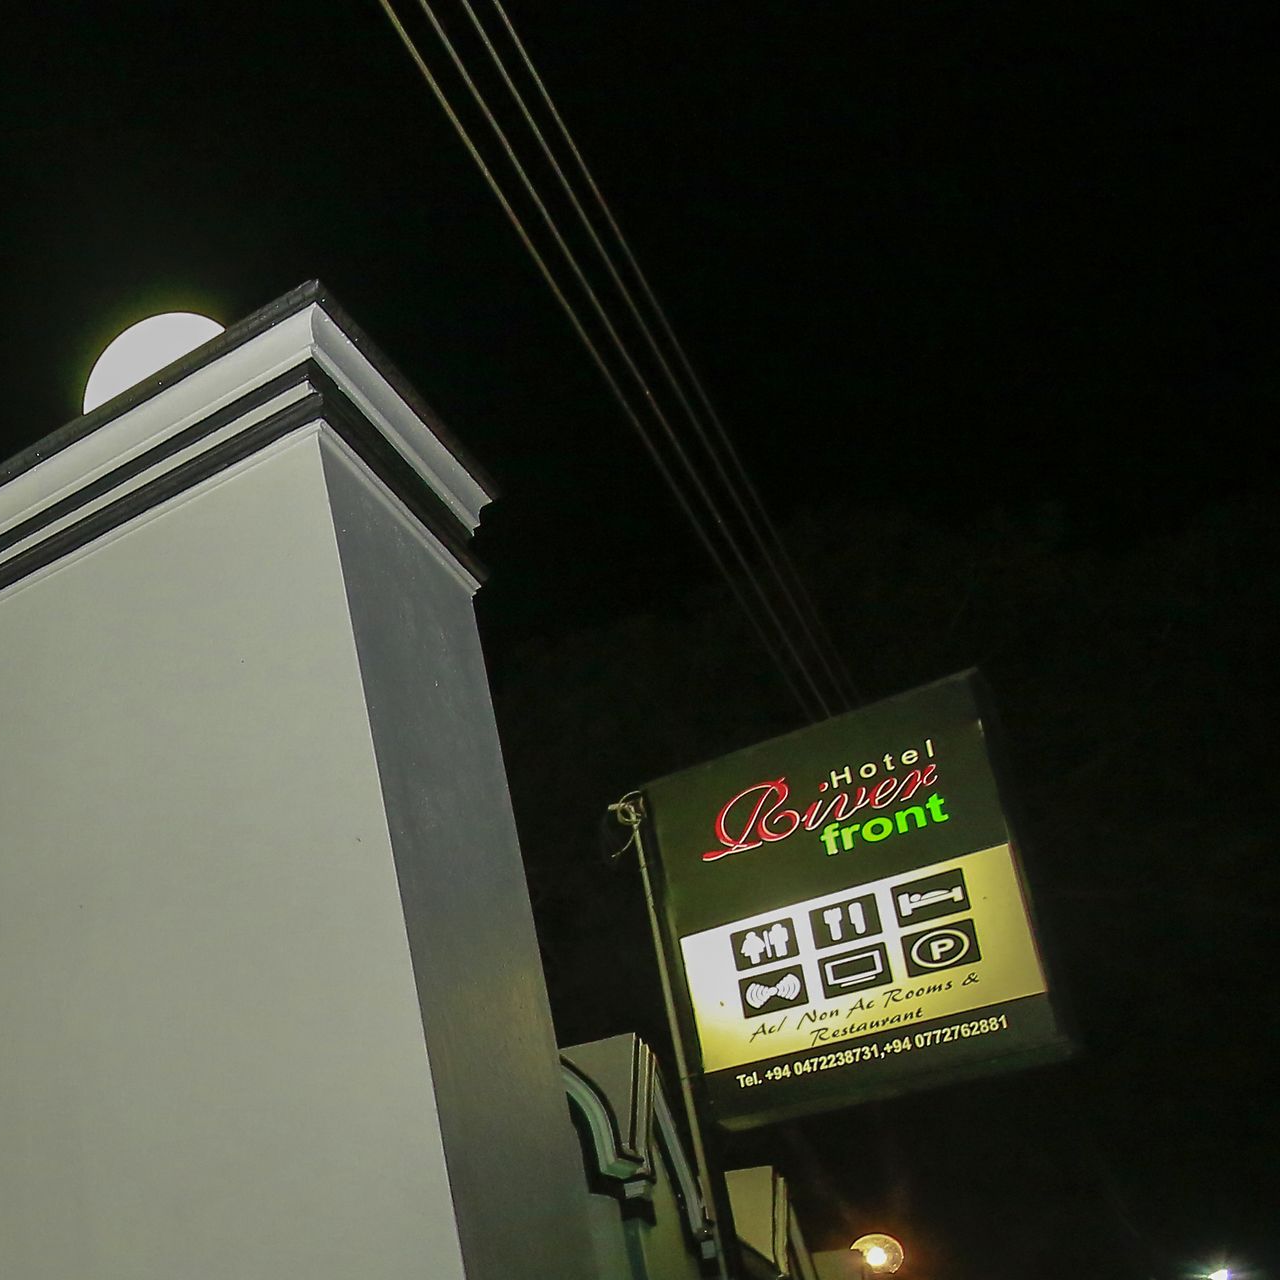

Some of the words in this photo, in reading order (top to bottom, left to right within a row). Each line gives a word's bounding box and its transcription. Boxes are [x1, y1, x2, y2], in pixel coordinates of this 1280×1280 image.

[830, 739, 934, 788] Hotel
[701, 763, 938, 861] River
[820, 793, 950, 856] front
[930, 938, 955, 961] P
[797, 1009, 839, 1030] Non
[846, 998, 874, 1019] Ac
[883, 980, 953, 1008] Rooms
[961, 972, 980, 986] &
[810, 1007, 924, 1047] Restaurant
[736, 1071, 762, 1088] Tel.
[765, 1064, 791, 1081] +94
[914, 1014, 1008, 1048] 0772762881
